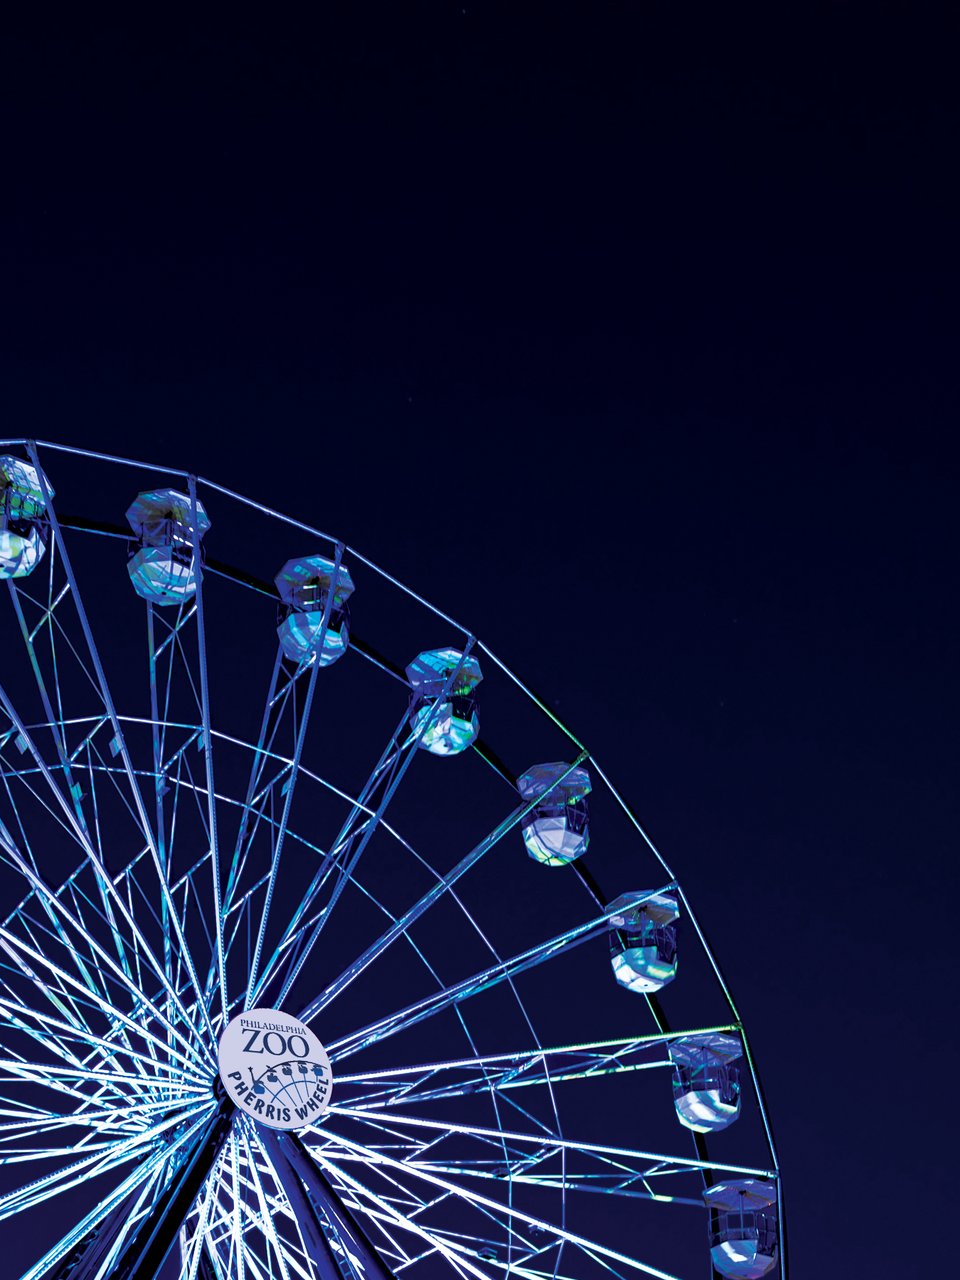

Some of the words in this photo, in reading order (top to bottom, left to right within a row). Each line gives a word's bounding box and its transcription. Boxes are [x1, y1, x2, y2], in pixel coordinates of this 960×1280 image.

[240, 1018, 306, 1035] PHILADELPHIA
[242, 1028, 310, 1058] ZOO
[228, 1071, 291, 1122] PHERRIS
[294, 1078, 329, 1121] WHEEL
